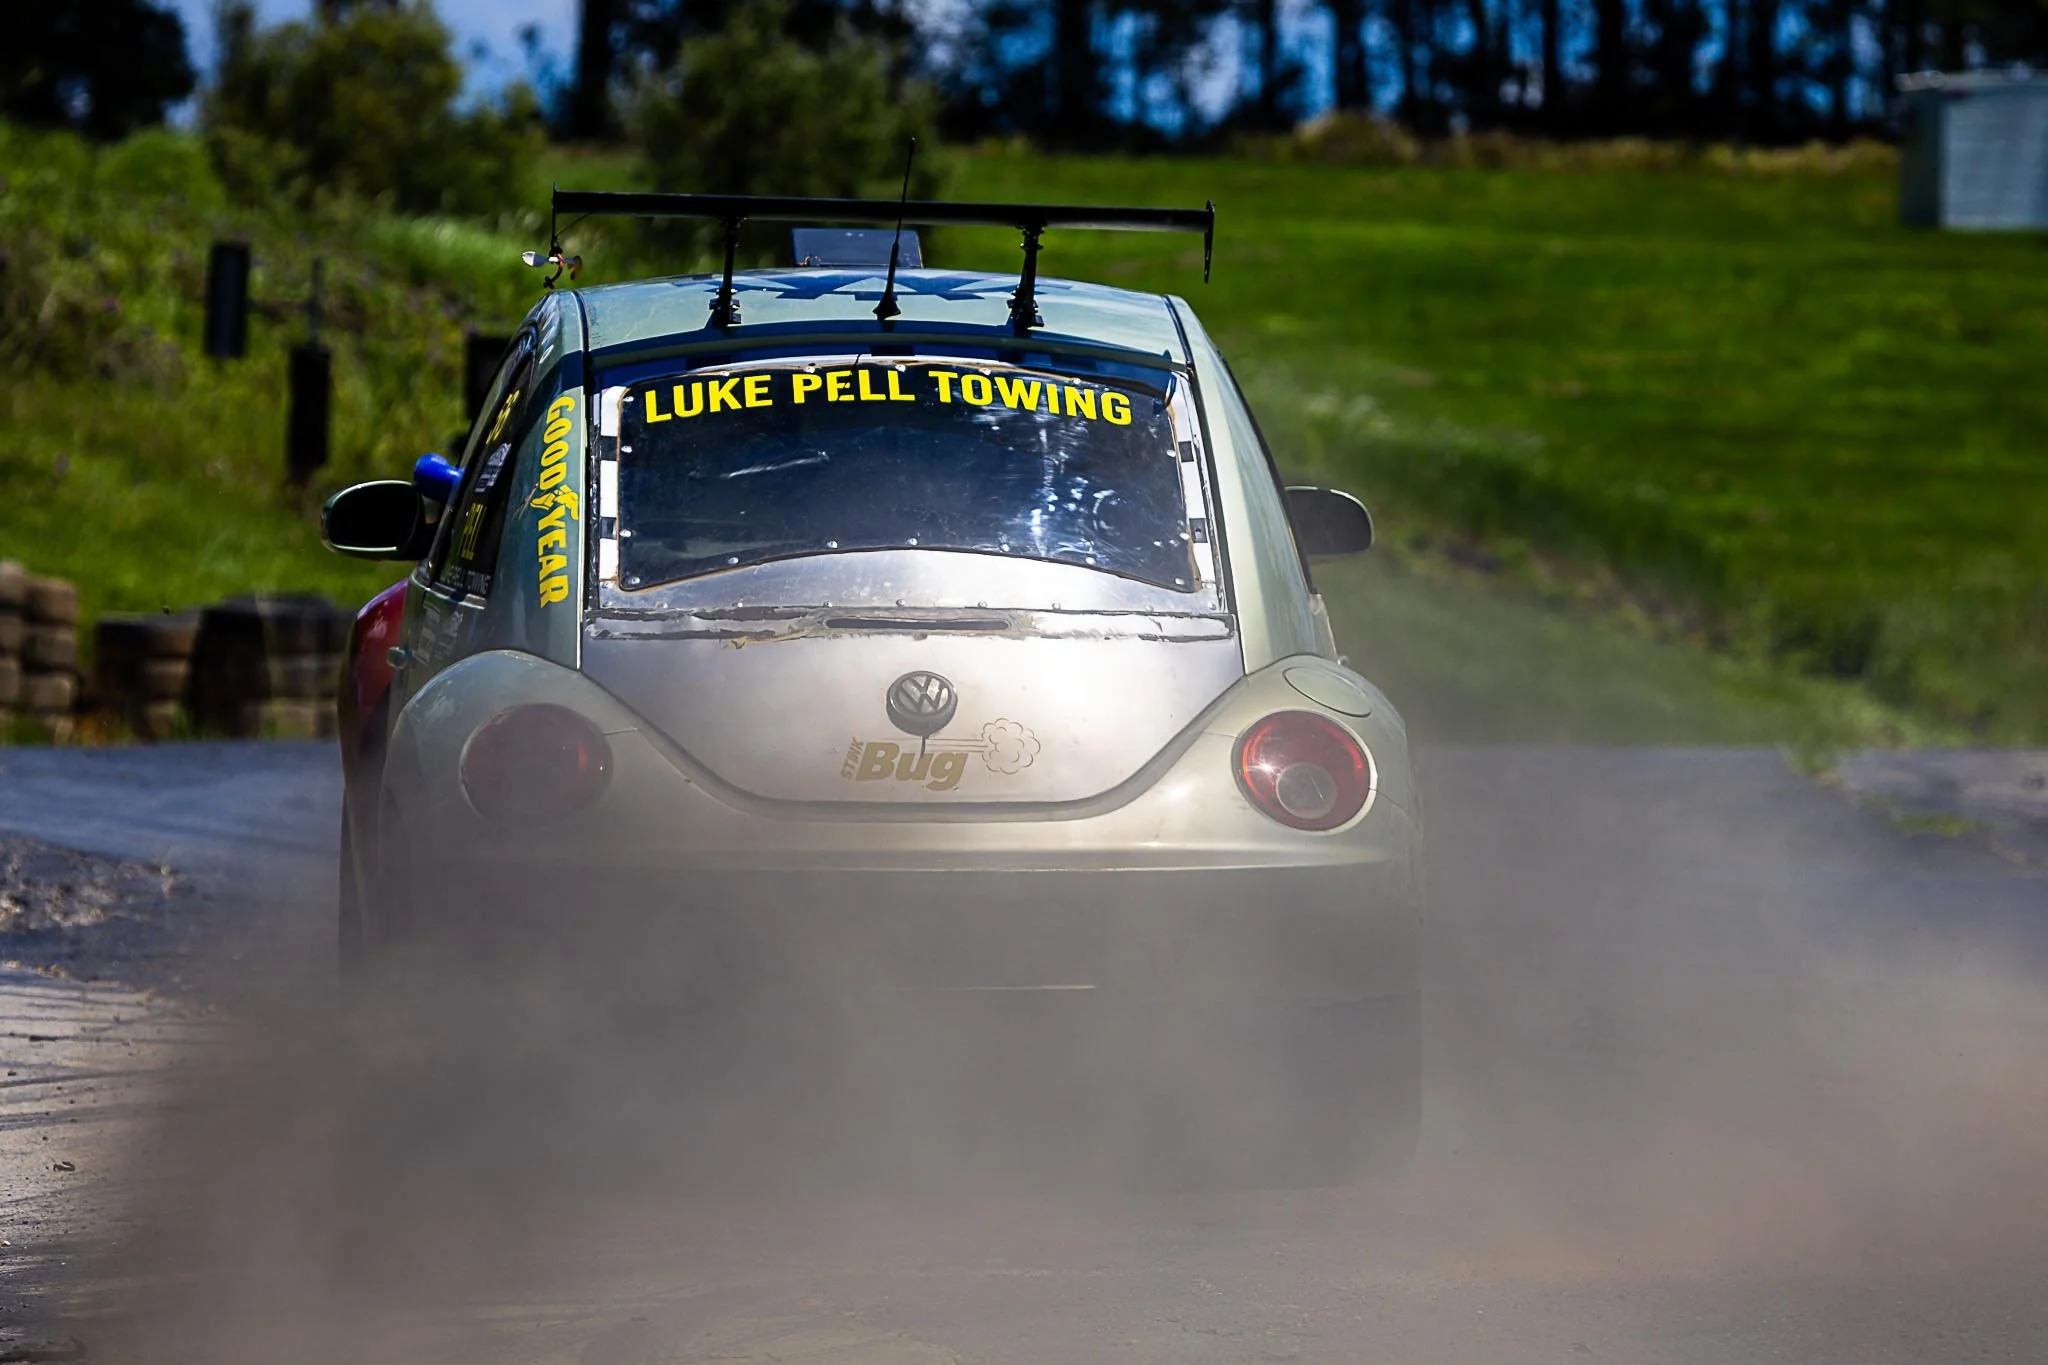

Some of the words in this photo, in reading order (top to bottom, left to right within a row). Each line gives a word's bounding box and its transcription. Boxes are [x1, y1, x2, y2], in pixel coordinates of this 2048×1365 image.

[644, 374, 773, 424] LUKE
[792, 370, 916, 404] PELL
[928, 370, 1132, 426] TOWING
[537, 396, 576, 609] GOODYEAR
[892, 671, 956, 717] VW
[840, 737, 864, 780] STINK
[855, 742, 969, 791] Bug
